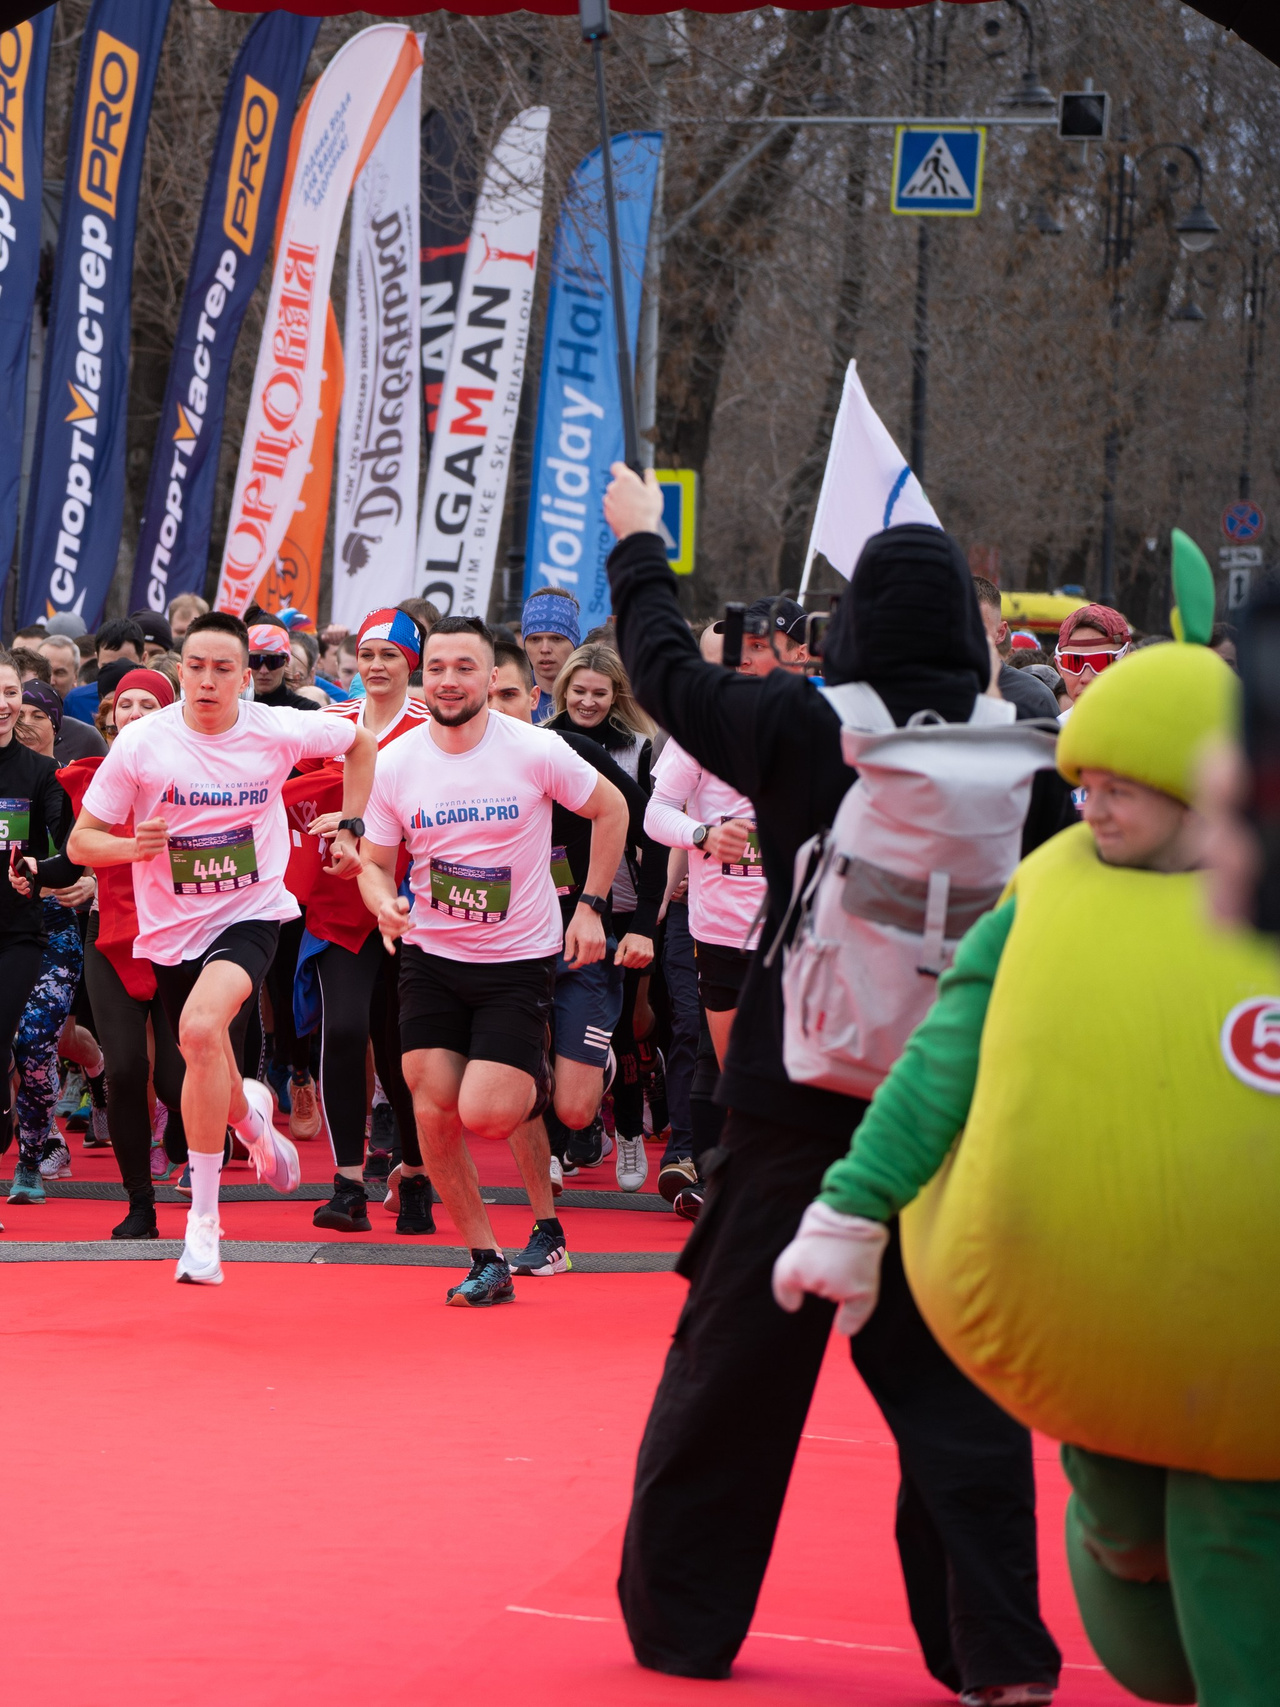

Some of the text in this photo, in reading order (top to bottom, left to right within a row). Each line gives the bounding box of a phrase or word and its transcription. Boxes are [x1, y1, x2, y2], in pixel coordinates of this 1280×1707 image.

[87, 51, 129, 202] PRO
[231, 94, 269, 238] PRO
[461, 288, 531, 616] SWIM BIKE SKI TRIATHLON
[225, 780, 269, 788] КОМПАНИЙ
[189, 788, 268, 806] CADR.PRO
[435, 796, 517, 808] ГРУППА КОМПАНИЙ
[435, 804, 520, 826] CADR.PRO
[193, 856, 237, 880] 444
[448, 886, 488, 910] 443
